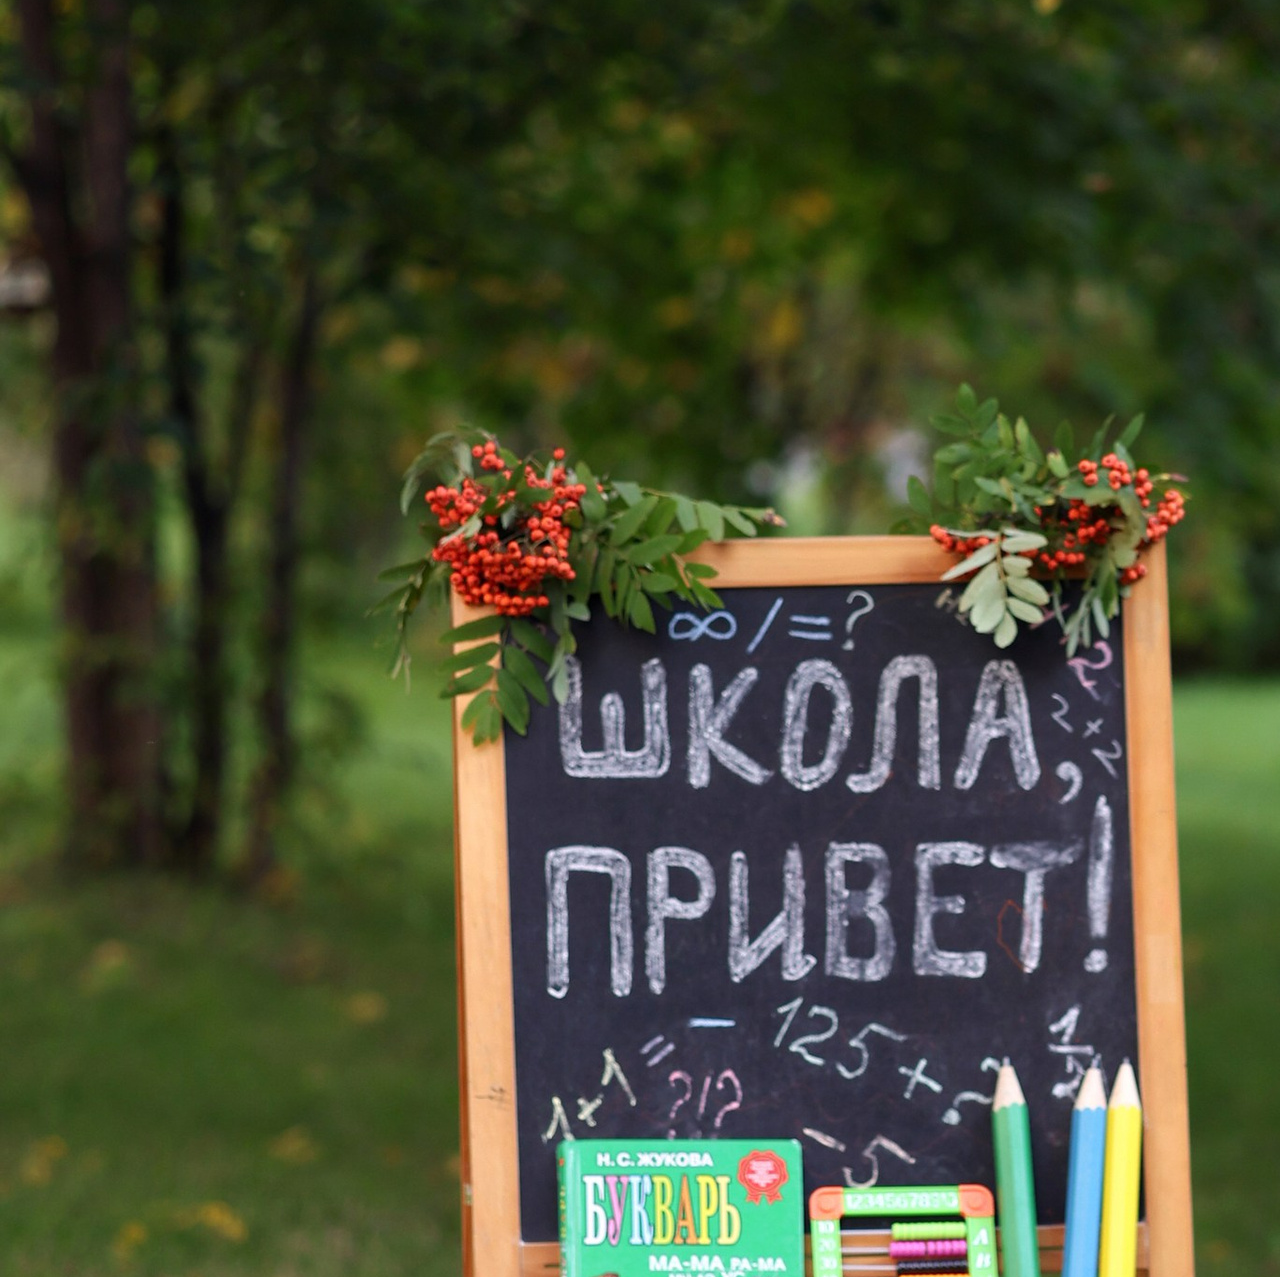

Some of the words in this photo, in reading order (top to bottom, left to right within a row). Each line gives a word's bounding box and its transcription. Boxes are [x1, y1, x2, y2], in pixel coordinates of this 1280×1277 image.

[559, 654, 1082, 804] ШКОЛА,
[545, 795, 1112, 999] ПРИВЕТ!
[637, 1152, 714, 1167] ЖУКОВА
[583, 1173, 742, 1246] БУКВАРЬ
[649, 1255, 724, 1272] МА-МА
[730, 1257, 786, 1272] РА-МА
